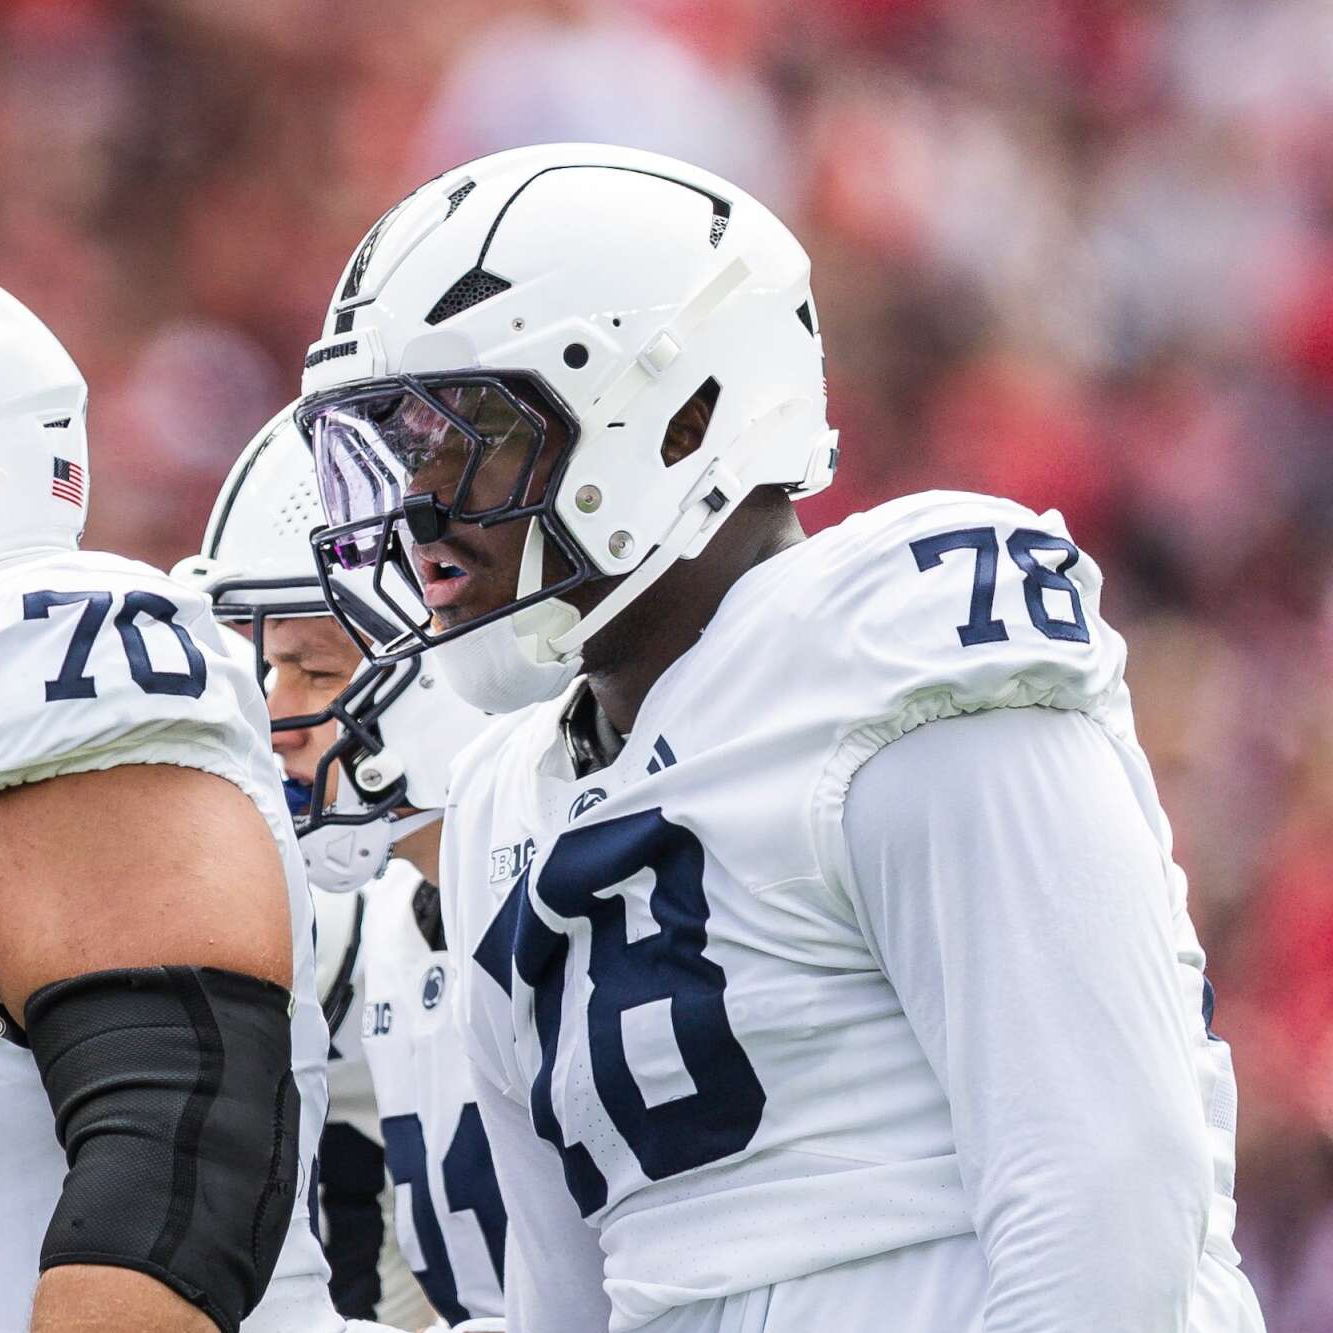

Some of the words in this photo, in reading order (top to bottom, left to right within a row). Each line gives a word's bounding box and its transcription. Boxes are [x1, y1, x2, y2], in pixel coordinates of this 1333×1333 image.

[22, 589, 208, 703] 70
[909, 526, 1090, 648] 78
[472, 806, 767, 1220] 78
